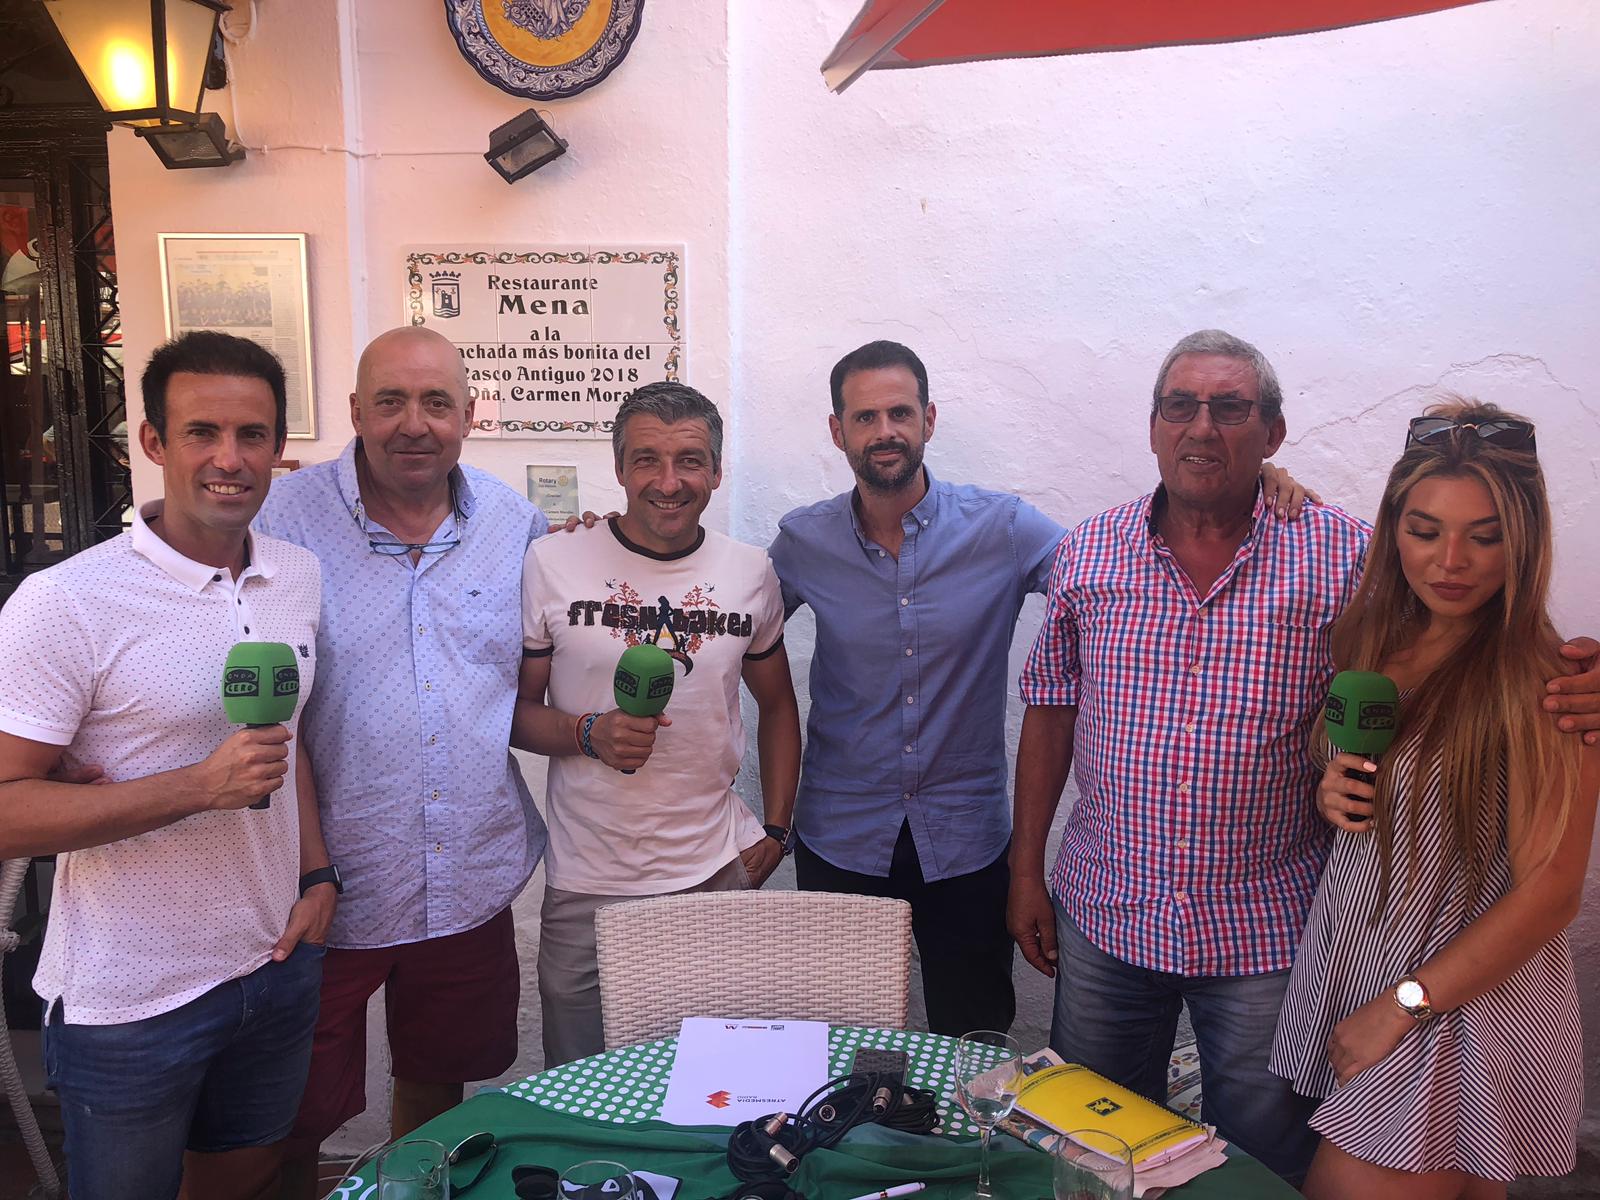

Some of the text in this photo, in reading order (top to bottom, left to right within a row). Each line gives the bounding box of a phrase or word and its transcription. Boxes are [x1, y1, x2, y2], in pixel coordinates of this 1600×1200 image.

[487, 274, 599, 291] Restaurante
[498, 294, 590, 315] Mena
[530, 326, 561, 341] a la
[456, 344, 651, 360] achada más bonita del
[516, 365, 586, 384] Antiguo
[590, 367, 639, 382] 2018
[510, 386, 581, 402] Carmen
[585, 387, 638, 402] Mora
[228, 683, 254, 692] CERO
